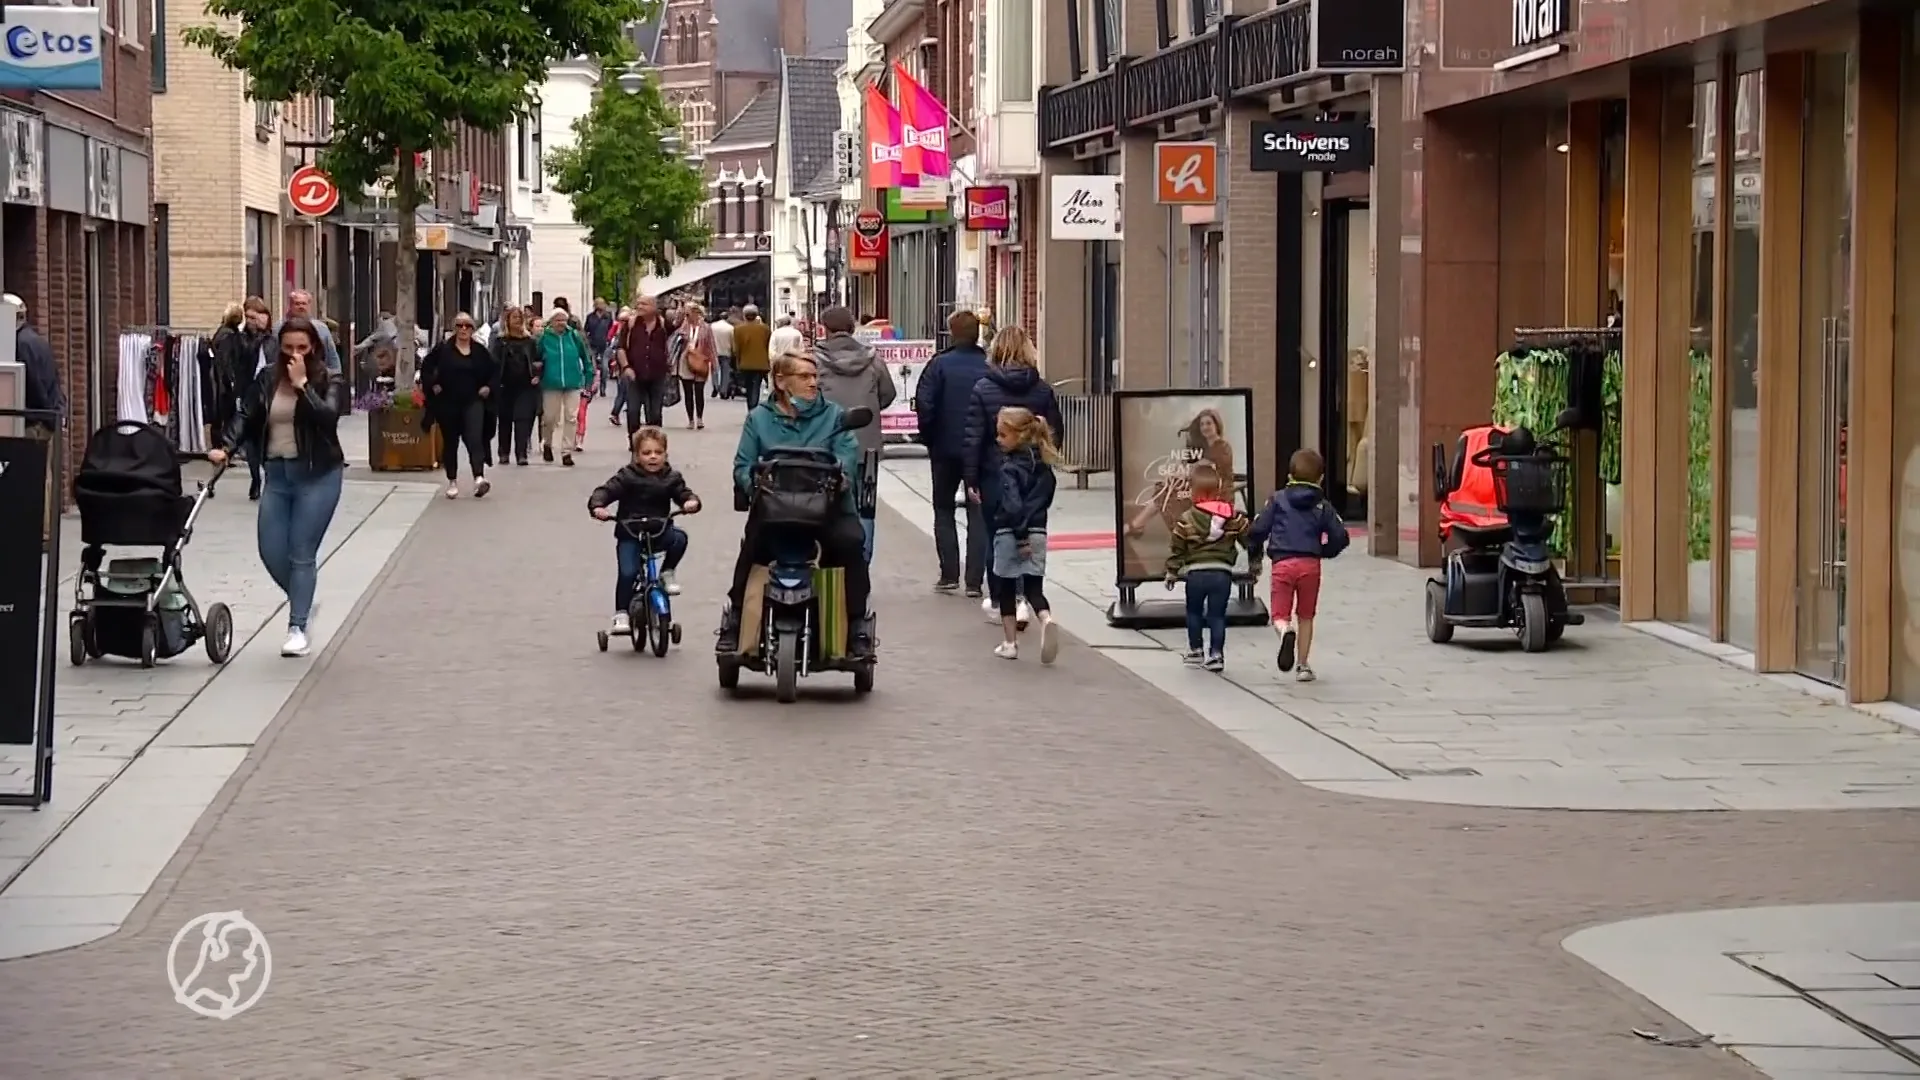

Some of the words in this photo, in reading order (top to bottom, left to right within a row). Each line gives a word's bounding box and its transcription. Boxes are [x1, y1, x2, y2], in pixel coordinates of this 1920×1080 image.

[6, 25, 93, 59] etos
[1342, 46, 1398, 60] norah
[1263, 132, 1350, 155] Schijvens
[1307, 152, 1337, 162] mode
[1061, 188, 1103, 207] Miss
[1170, 448, 1204, 461] NEW
[1158, 463, 1190, 476] SEA
